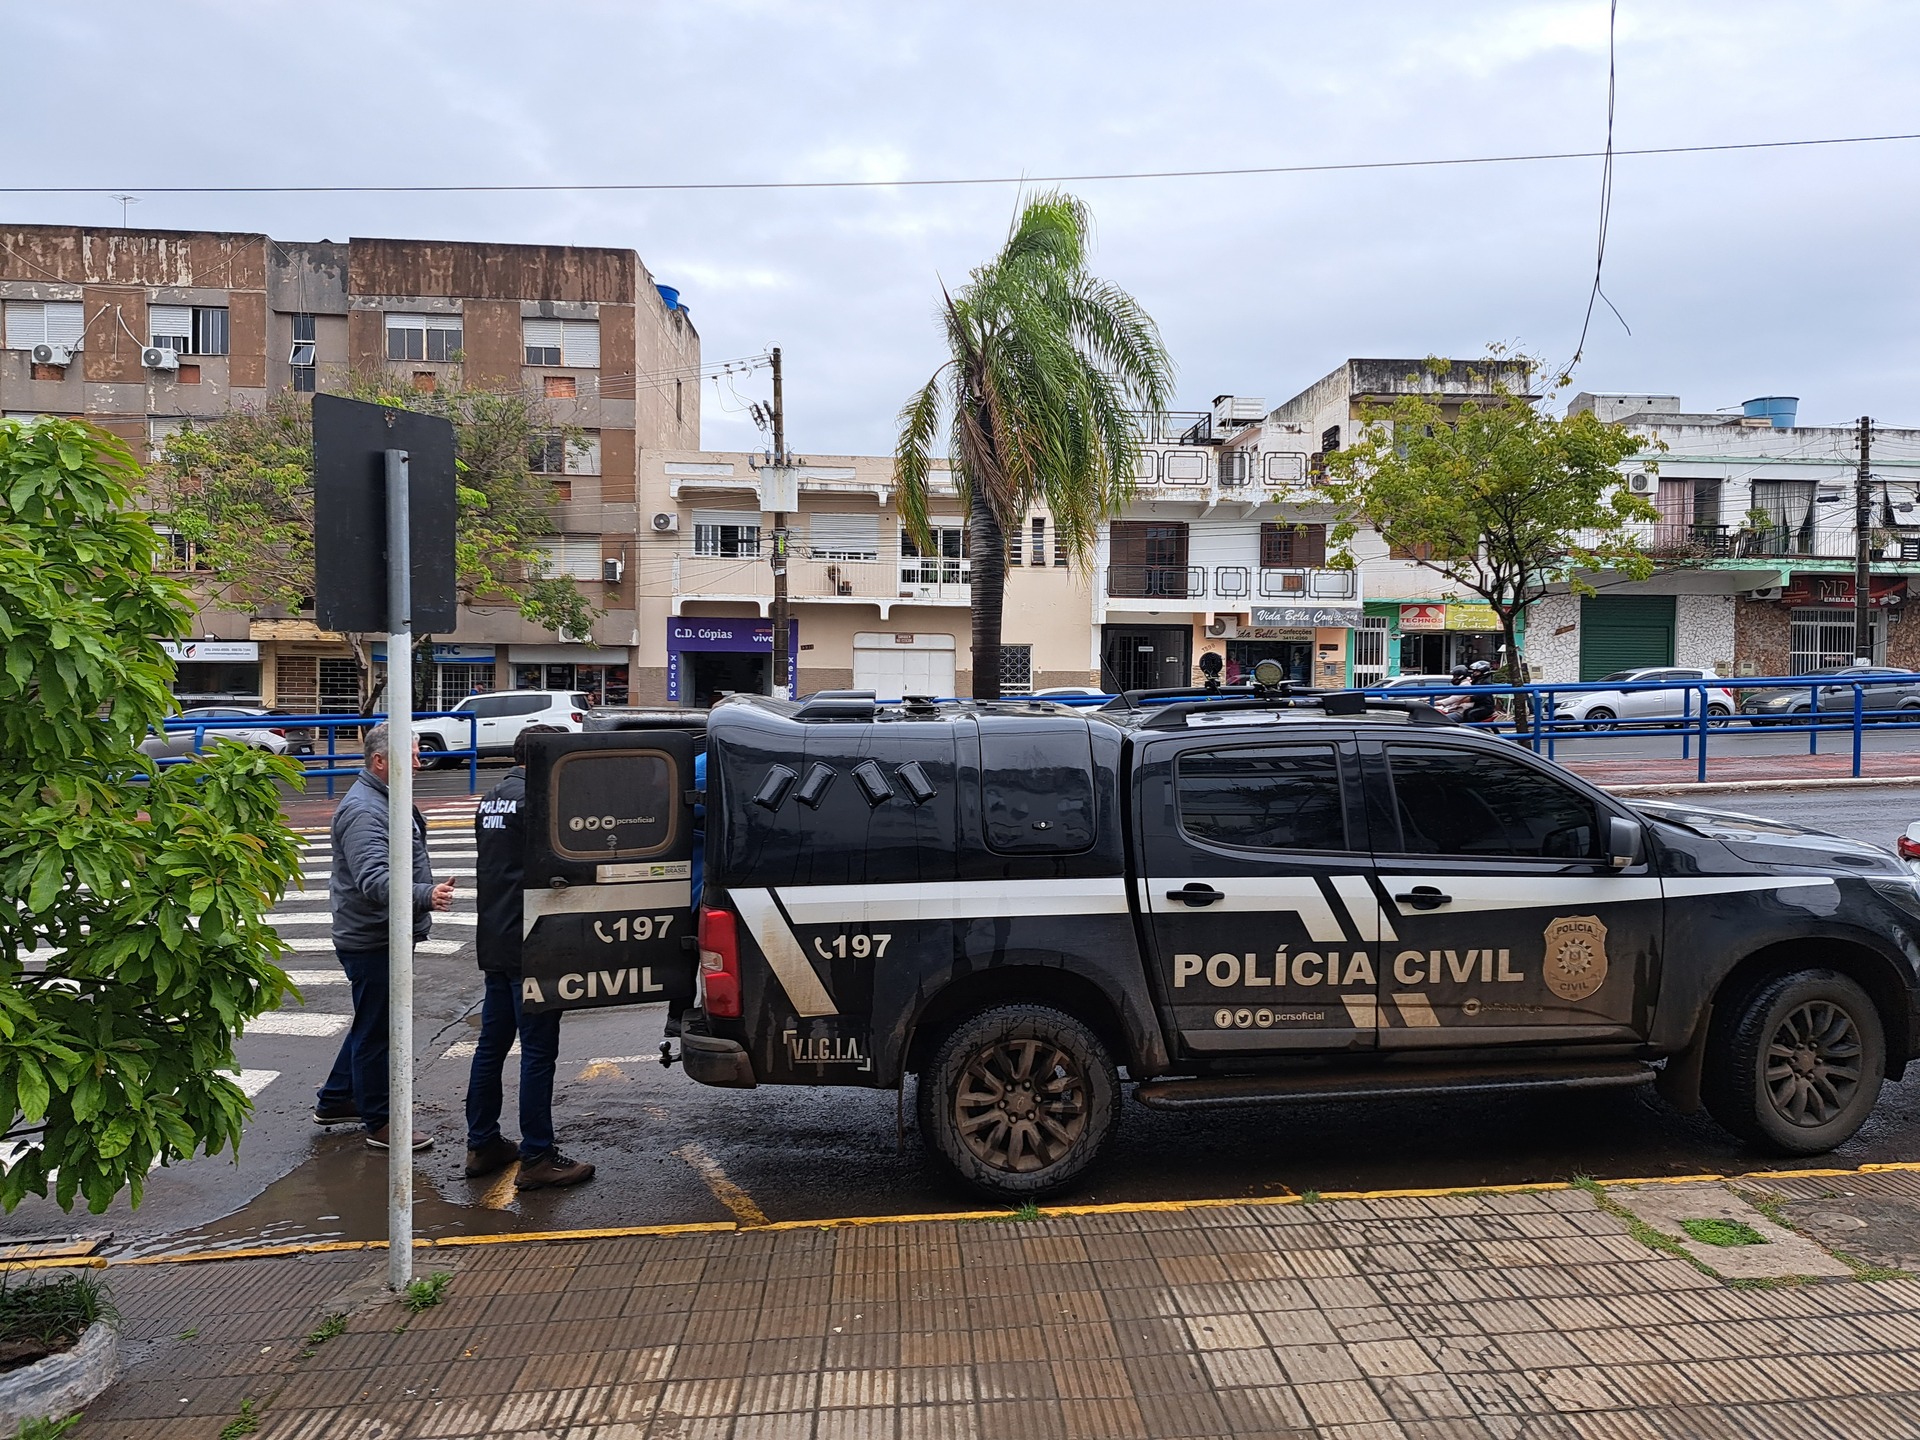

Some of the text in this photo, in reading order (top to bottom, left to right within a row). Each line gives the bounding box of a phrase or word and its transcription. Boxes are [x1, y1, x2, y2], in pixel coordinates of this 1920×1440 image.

[1818, 579, 1849, 600] MP
[1256, 609, 1281, 621] Vida
[1284, 609, 1310, 621] Bella
[674, 628, 733, 641] C.D. Cópias
[1236, 628, 1279, 639] ida Bella
[478, 797, 517, 814] POLÍCIA
[482, 815, 507, 829] CIVIL
[616, 816, 655, 827] pcrsoficial
[612, 915, 674, 942] 197
[832, 934, 892, 959] 197
[1173, 944, 1525, 988] POLÍCIA CIVIL
[522, 966, 664, 1004] A CIVIL
[1559, 981, 1589, 991] CIVIL
[1274, 1011, 1325, 1023] pcrsoficial
